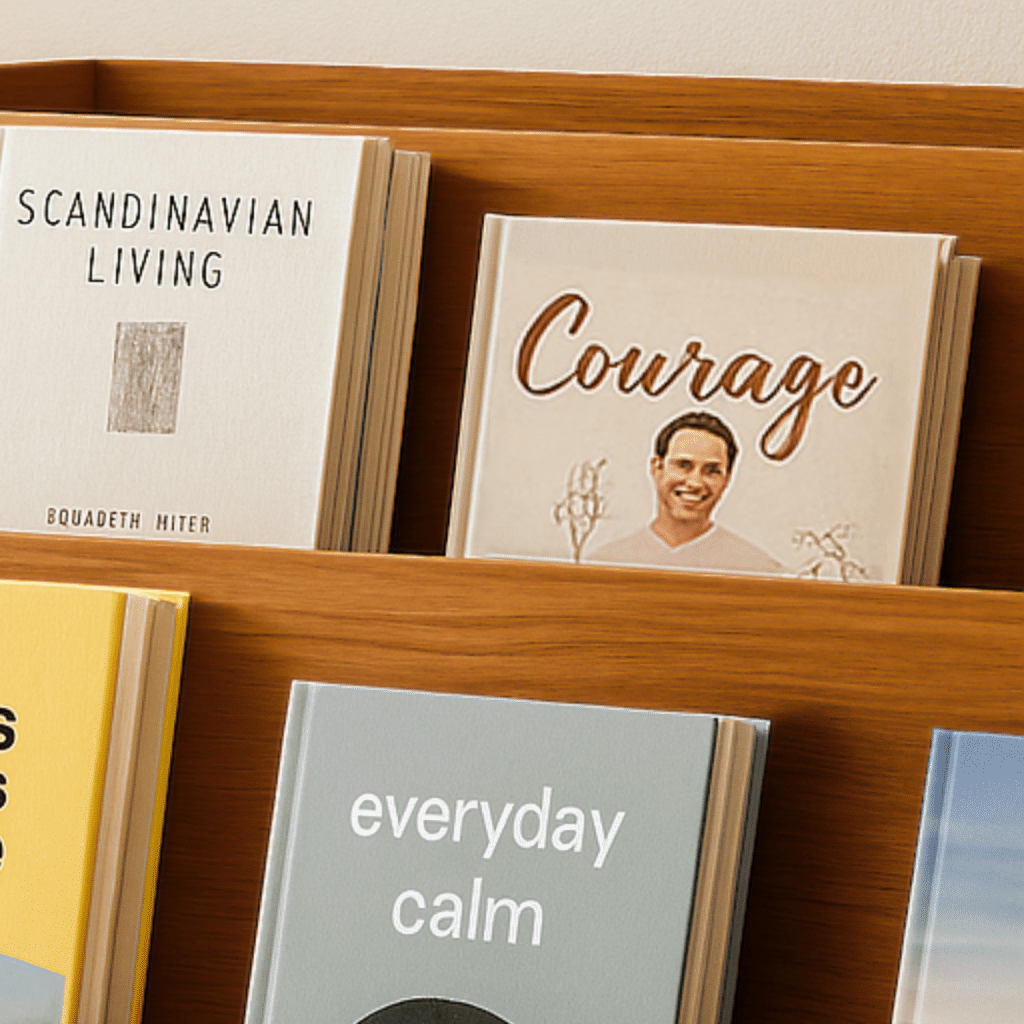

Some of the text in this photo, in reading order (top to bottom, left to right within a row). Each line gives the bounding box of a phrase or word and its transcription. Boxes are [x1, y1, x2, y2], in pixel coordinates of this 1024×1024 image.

[16, 188, 314, 237] SCANDINAVIAN
[86, 246, 224, 289] LIVING
[516, 292, 878, 462] Courage
[349, 786, 626, 869] everyday
[391, 877, 544, 947] calm
